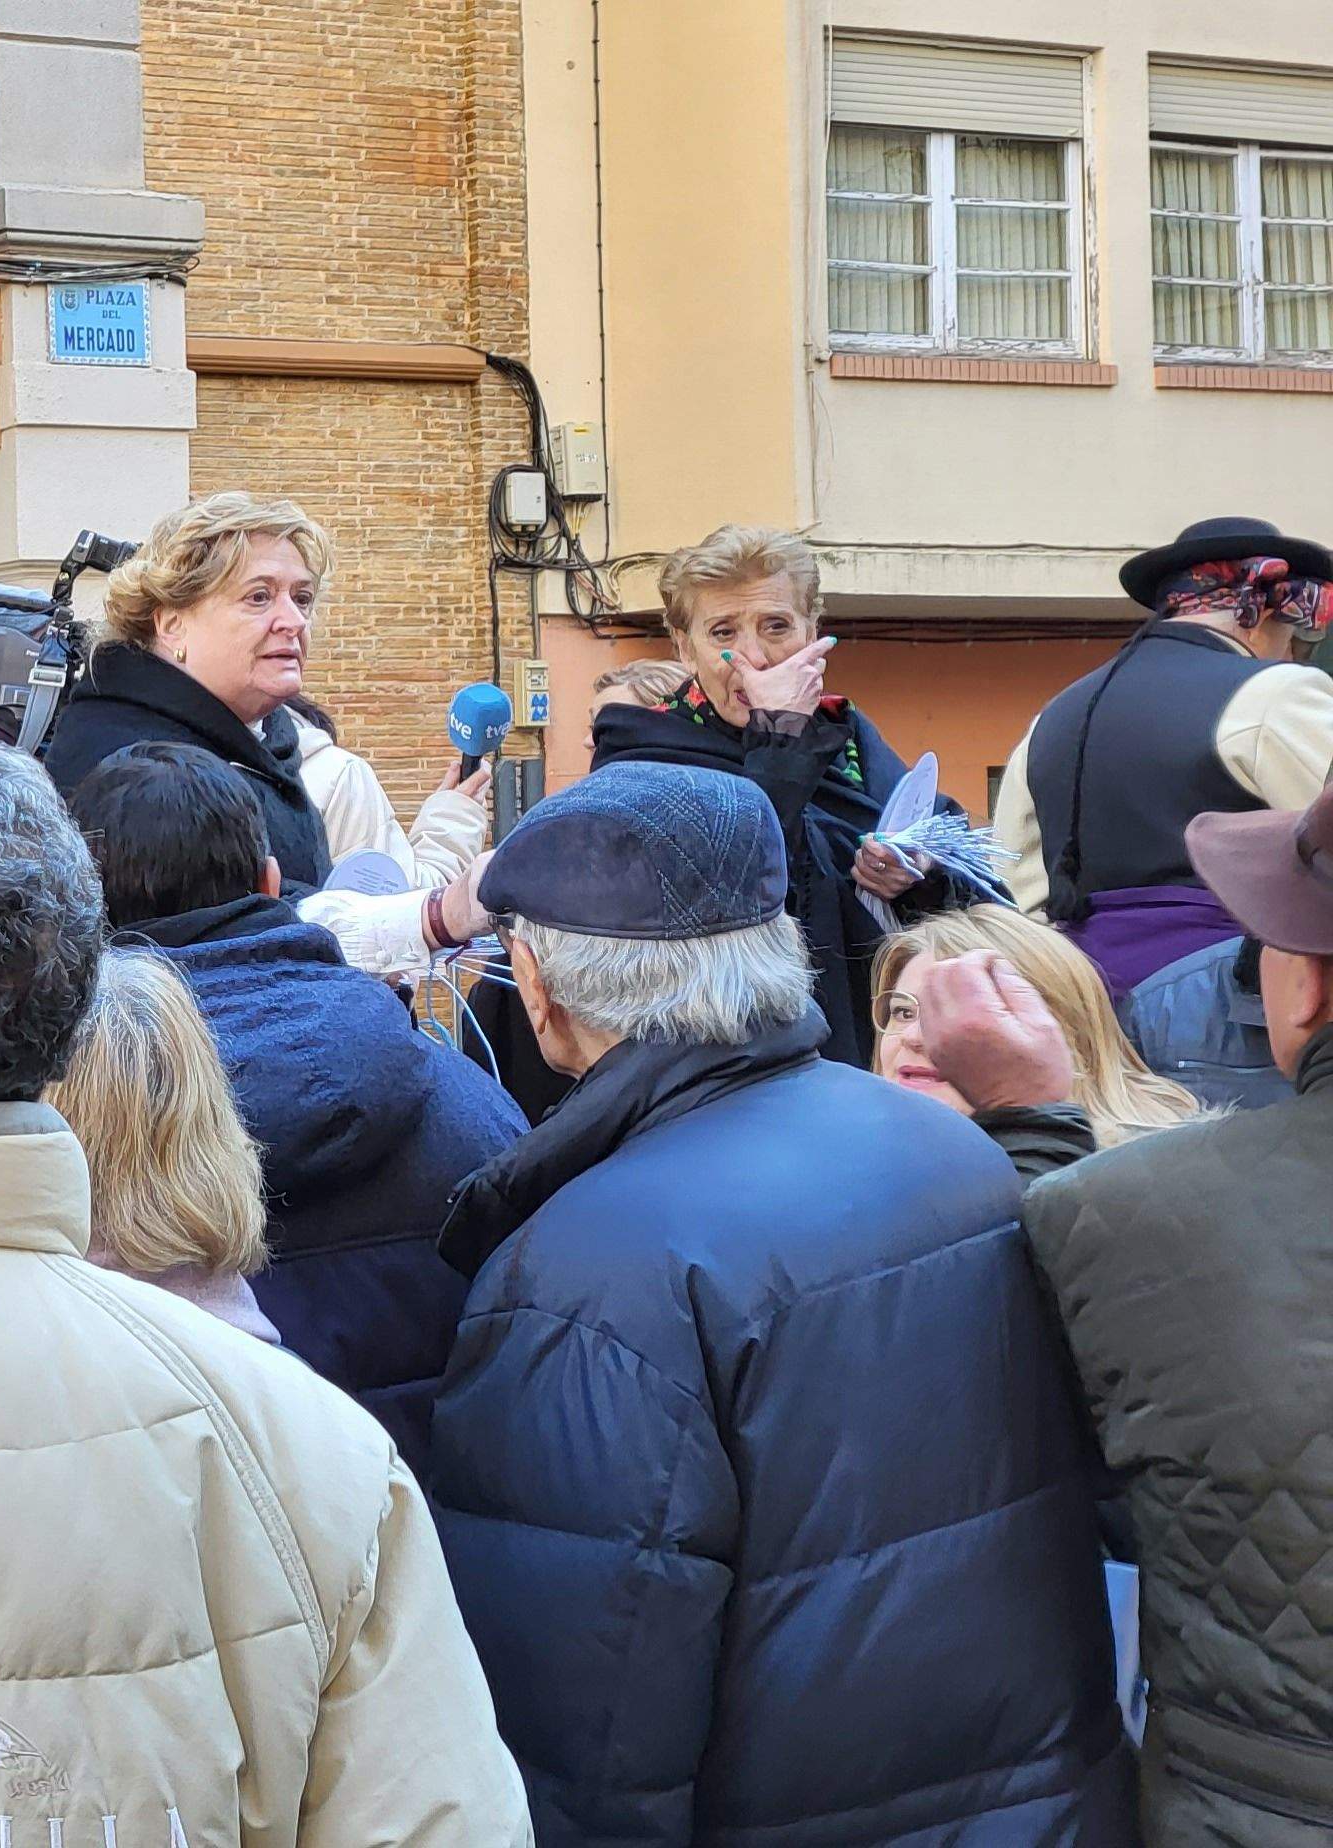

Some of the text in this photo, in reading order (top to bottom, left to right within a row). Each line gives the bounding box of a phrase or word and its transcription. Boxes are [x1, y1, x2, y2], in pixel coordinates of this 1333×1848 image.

[86, 289, 137, 306] PLAZA
[102, 309, 121, 319] DEL
[64, 325, 136, 352] MERCADO
[450, 713, 472, 740] tve
[485, 721, 510, 739] tve
